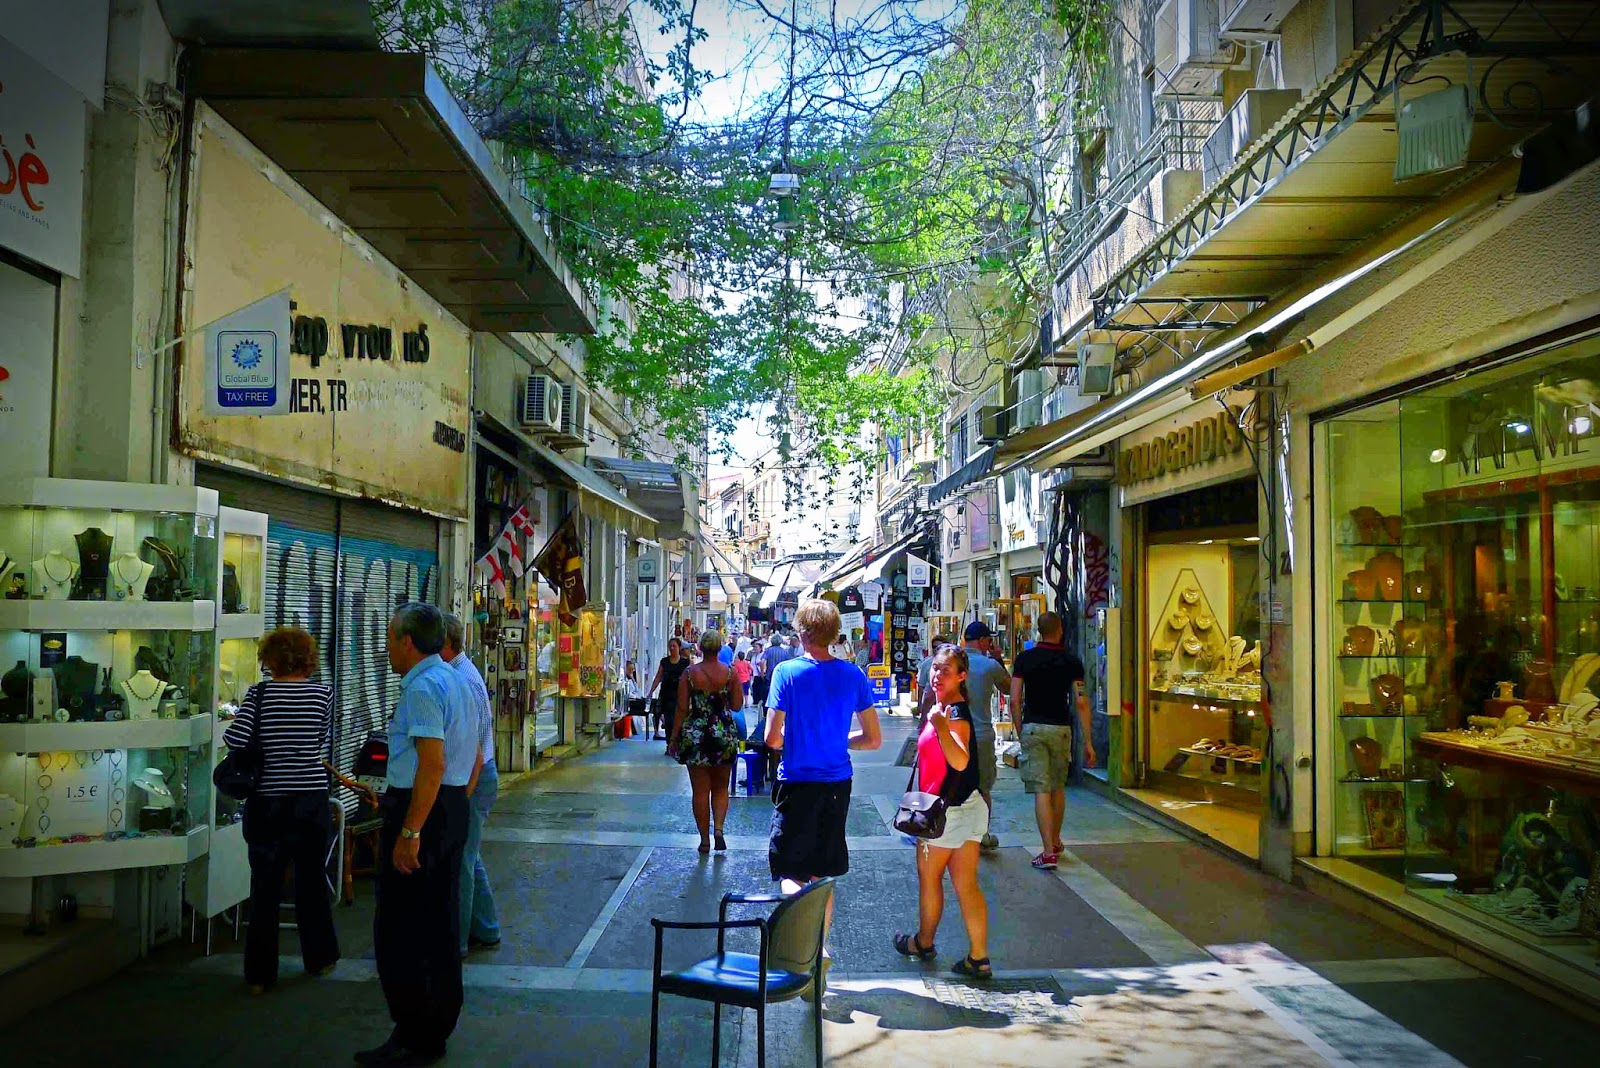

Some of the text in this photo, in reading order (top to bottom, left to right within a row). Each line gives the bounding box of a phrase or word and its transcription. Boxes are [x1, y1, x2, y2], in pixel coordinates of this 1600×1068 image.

[225, 374, 269, 384] Global Blue
[225, 391, 269, 402] TAX FREE
[66, 785, 98, 798] 1.5 €
